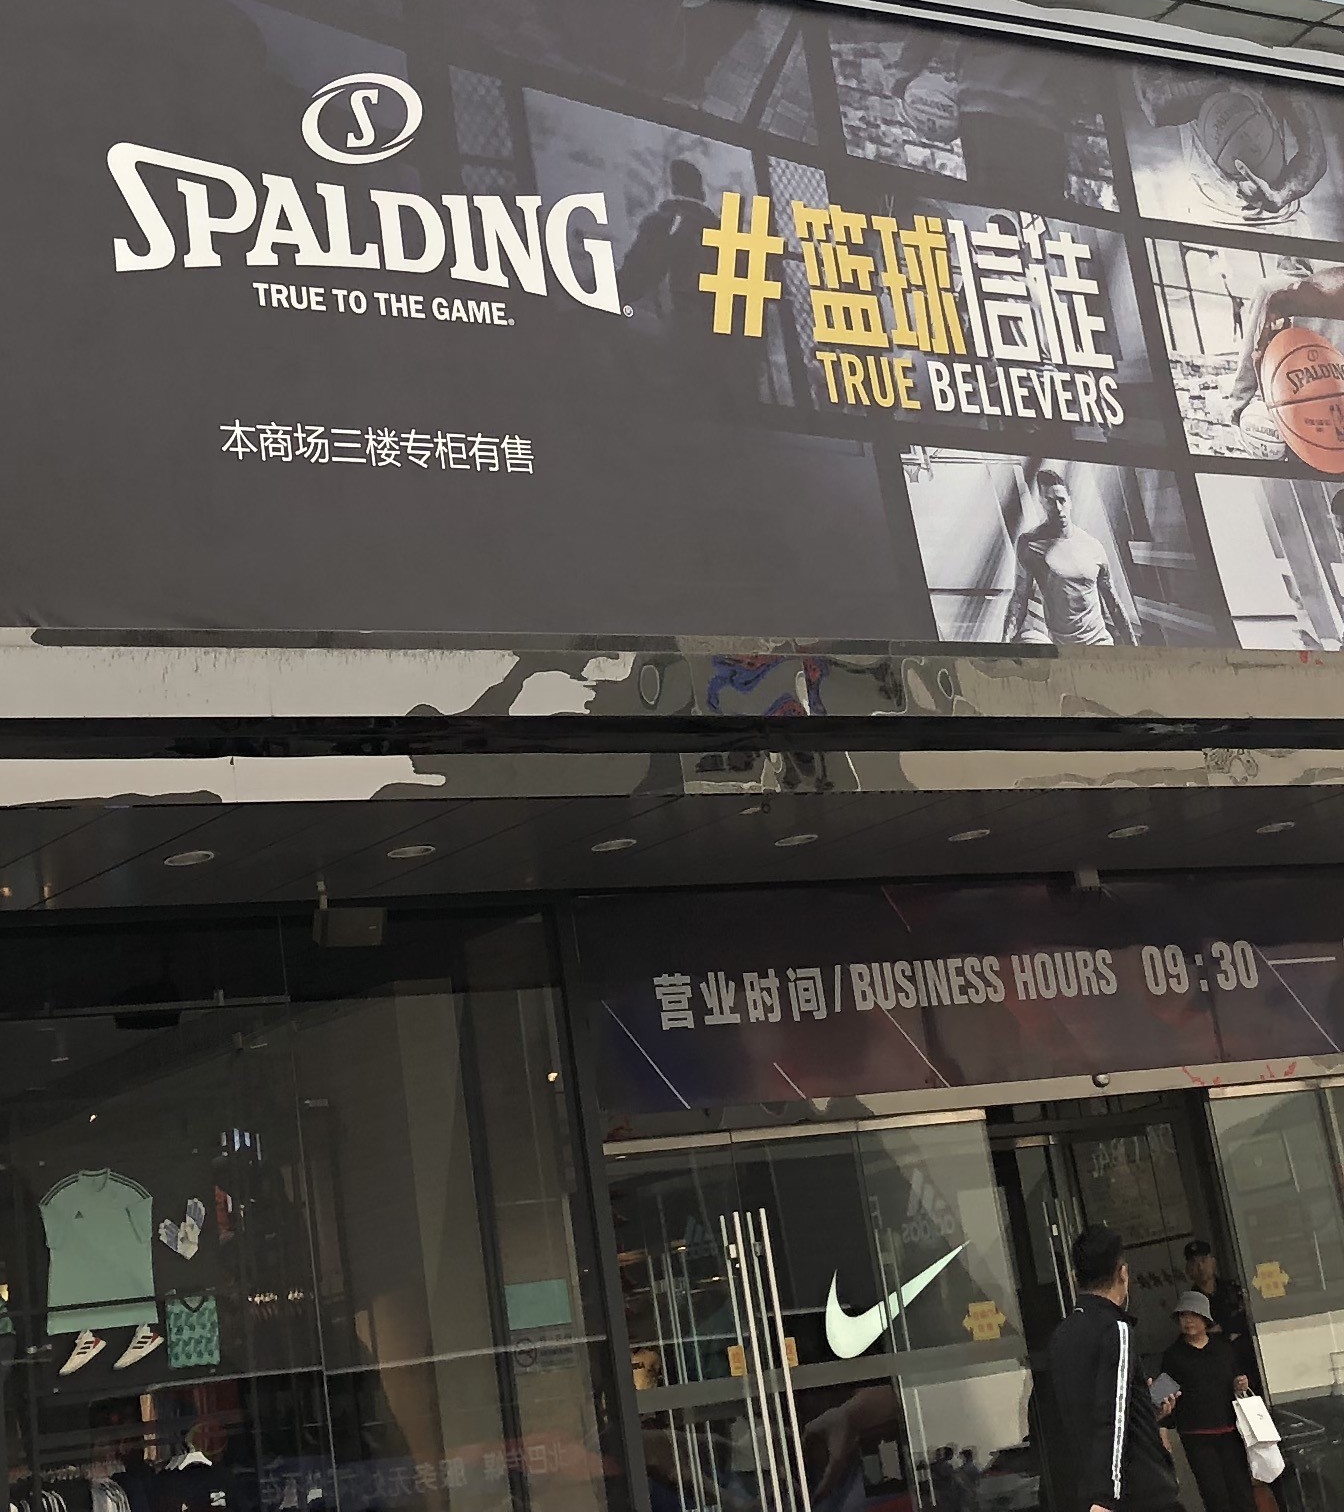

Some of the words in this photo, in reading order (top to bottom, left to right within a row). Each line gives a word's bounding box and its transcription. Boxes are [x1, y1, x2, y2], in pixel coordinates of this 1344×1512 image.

[107, 141, 621, 315] SPALDING
[252, 282, 327, 312] TRUE
[331, 288, 367, 314] TO
[374, 292, 426, 319] THE
[815, 350, 921, 411] TRUE
[927, 360, 1125, 426] BELIEVERS
[220, 419, 535, 475] 本商场三楼专柜有售
[1011, 948, 1118, 1001] HOURS
[1141, 940, 1258, 995] 09:30
